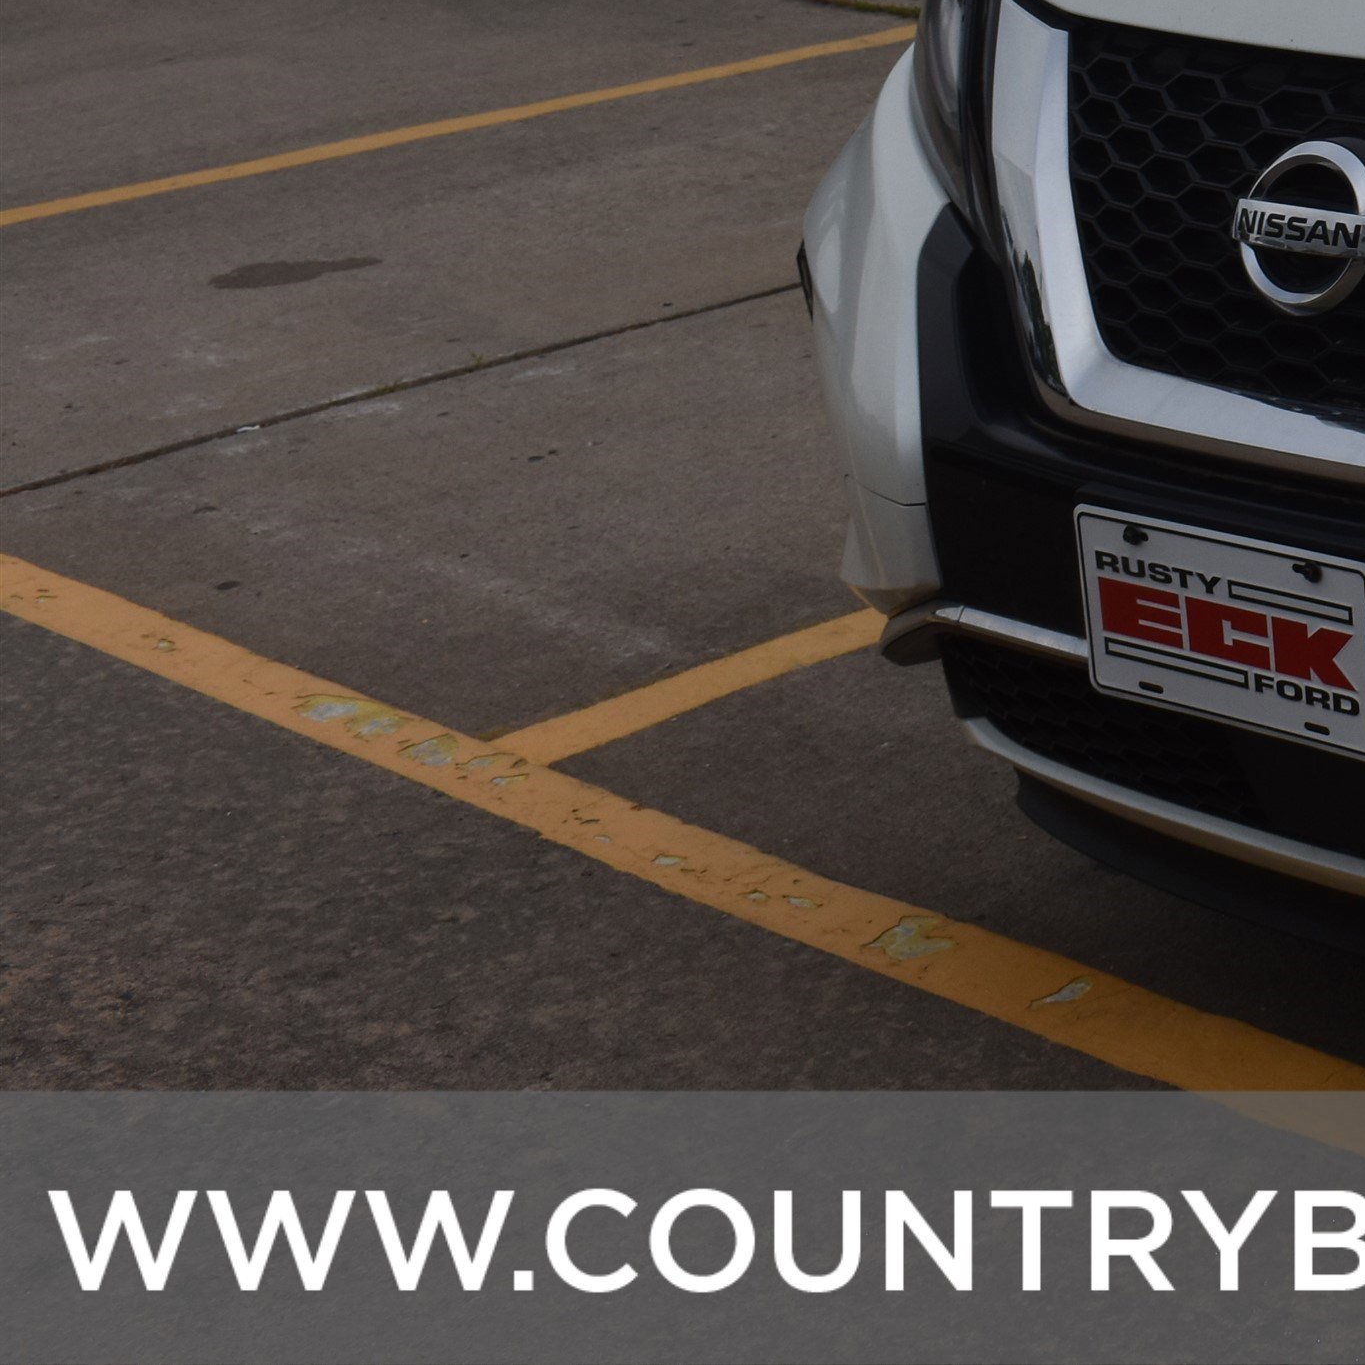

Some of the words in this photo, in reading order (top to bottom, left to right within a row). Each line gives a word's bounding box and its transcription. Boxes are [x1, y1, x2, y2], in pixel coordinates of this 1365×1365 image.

[1237, 208, 1362, 249] NISSAN
[1095, 550, 1221, 595] RUSTY
[1098, 576, 1358, 693] ECK
[1254, 673, 1361, 717] FORD
